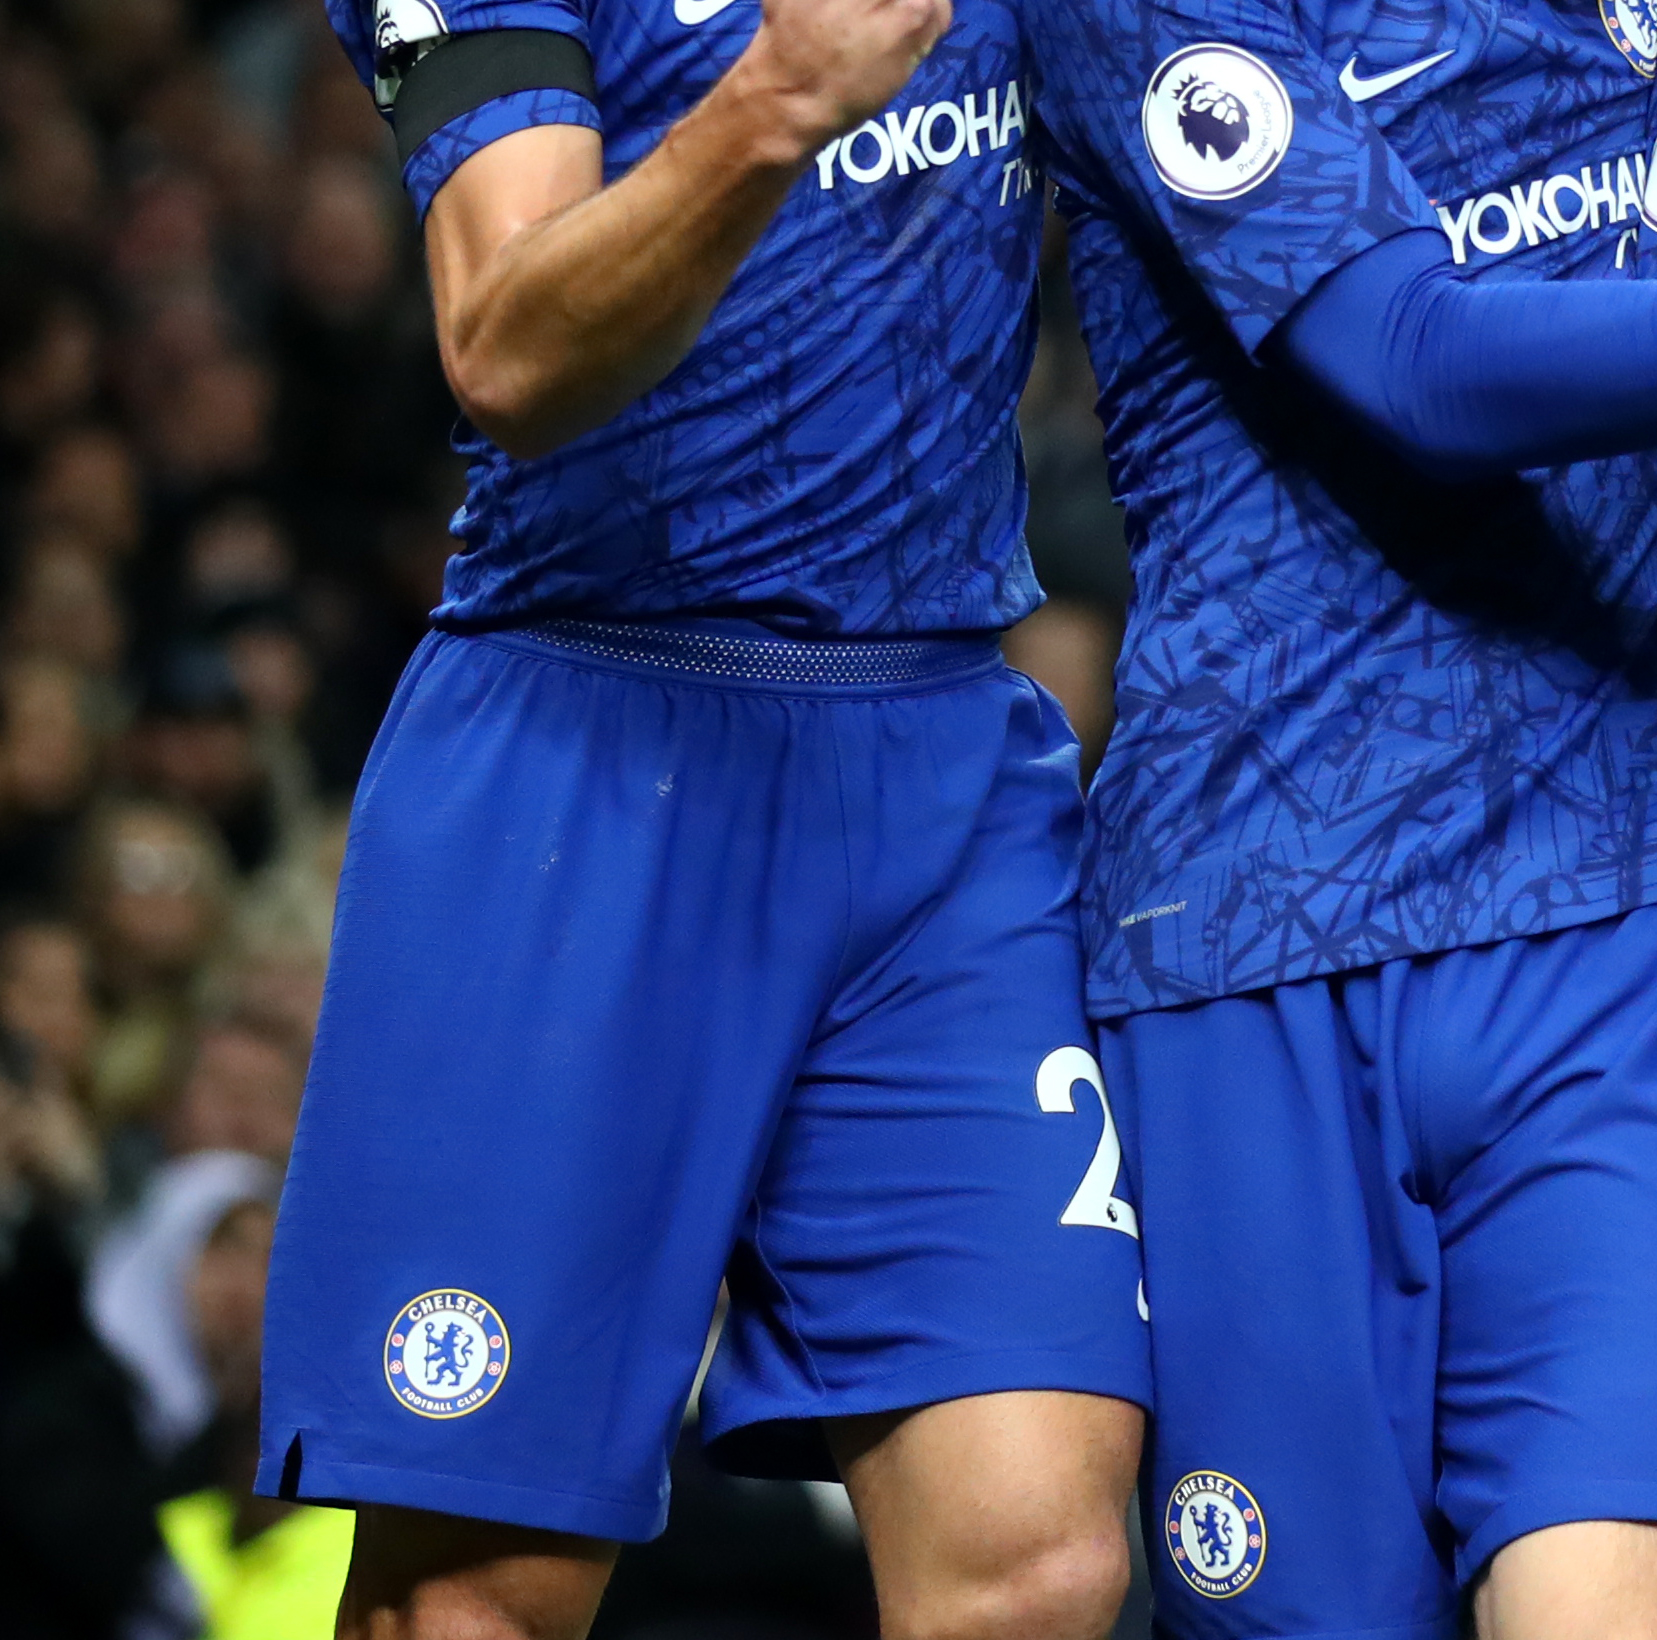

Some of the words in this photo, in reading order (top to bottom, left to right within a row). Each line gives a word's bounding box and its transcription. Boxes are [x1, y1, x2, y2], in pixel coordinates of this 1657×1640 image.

[815, 79, 1031, 190] YOKOHA
[408, 1295, 488, 1324] CHELSEA
[401, 1386, 453, 1411] FOOTBALL
[456, 1387, 485, 1408] CLUB
[1175, 1476, 1235, 1506] CHELSEA
[1190, 1571, 1231, 1592] FOOTBALL
[1231, 1562, 1253, 1586] CLUB
